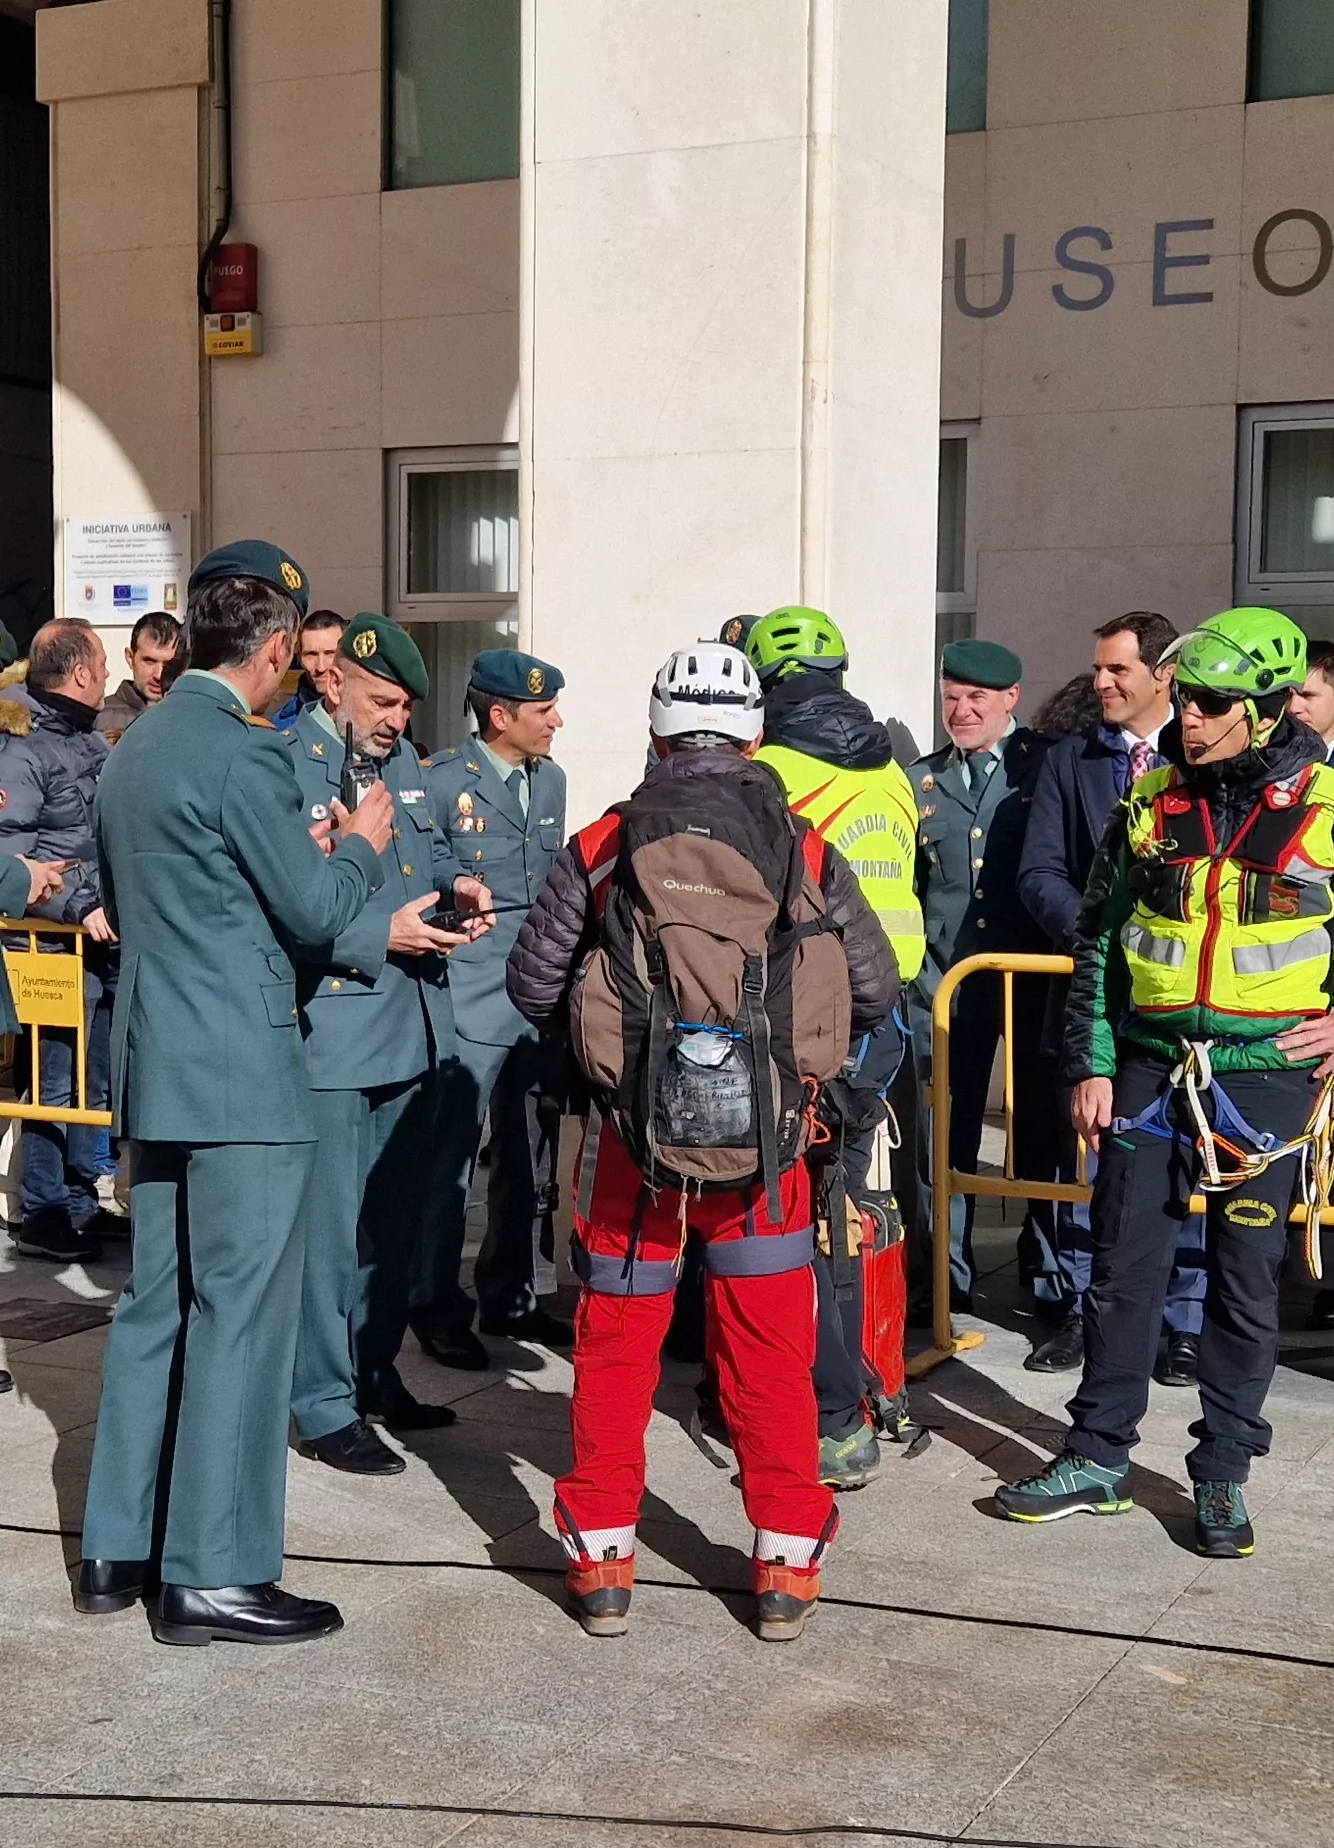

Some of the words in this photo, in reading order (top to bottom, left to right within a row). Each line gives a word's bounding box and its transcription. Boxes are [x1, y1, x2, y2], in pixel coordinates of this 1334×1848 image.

[83, 524, 130, 535] INICIATIVA
[132, 522, 172, 534] URBANA
[663, 879, 726, 897] Quechua
[22, 975, 75, 989] Ayuntamiento
[22, 989, 31, 998] de
[34, 989, 63, 1001] Huesca
